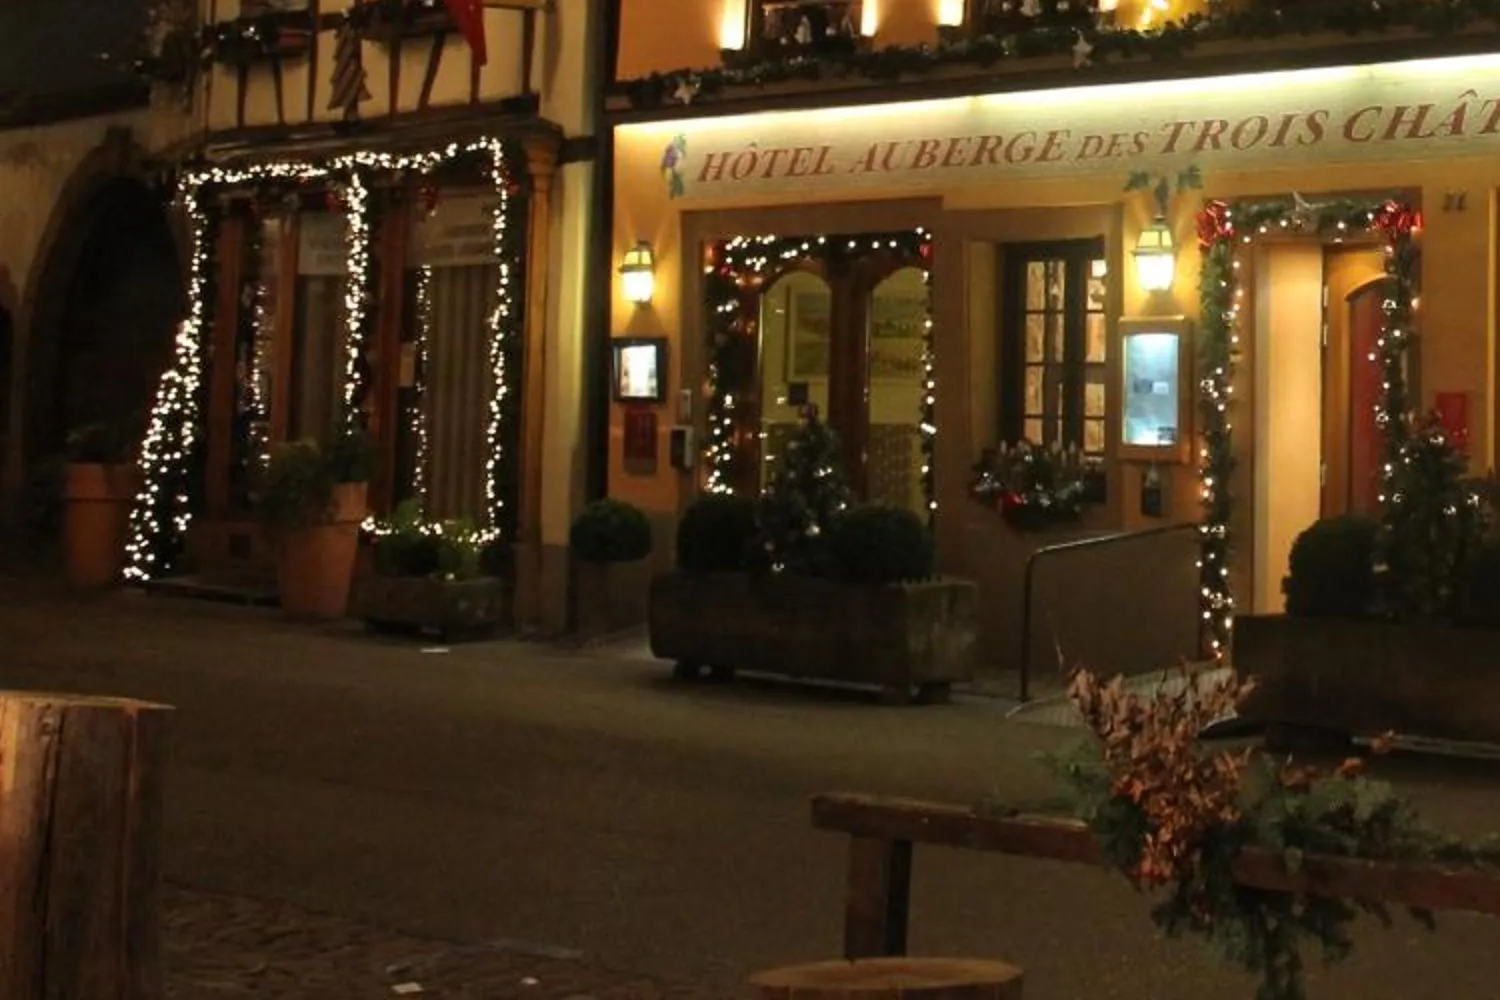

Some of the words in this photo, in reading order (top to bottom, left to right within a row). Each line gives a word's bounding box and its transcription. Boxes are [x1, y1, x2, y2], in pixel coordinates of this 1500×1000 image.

[697, 142, 834, 183] HÔTEL
[849, 129, 1070, 175] AUBERGE
[1076, 130, 1151, 160] DES
[1160, 108, 1330, 156] TROIS
